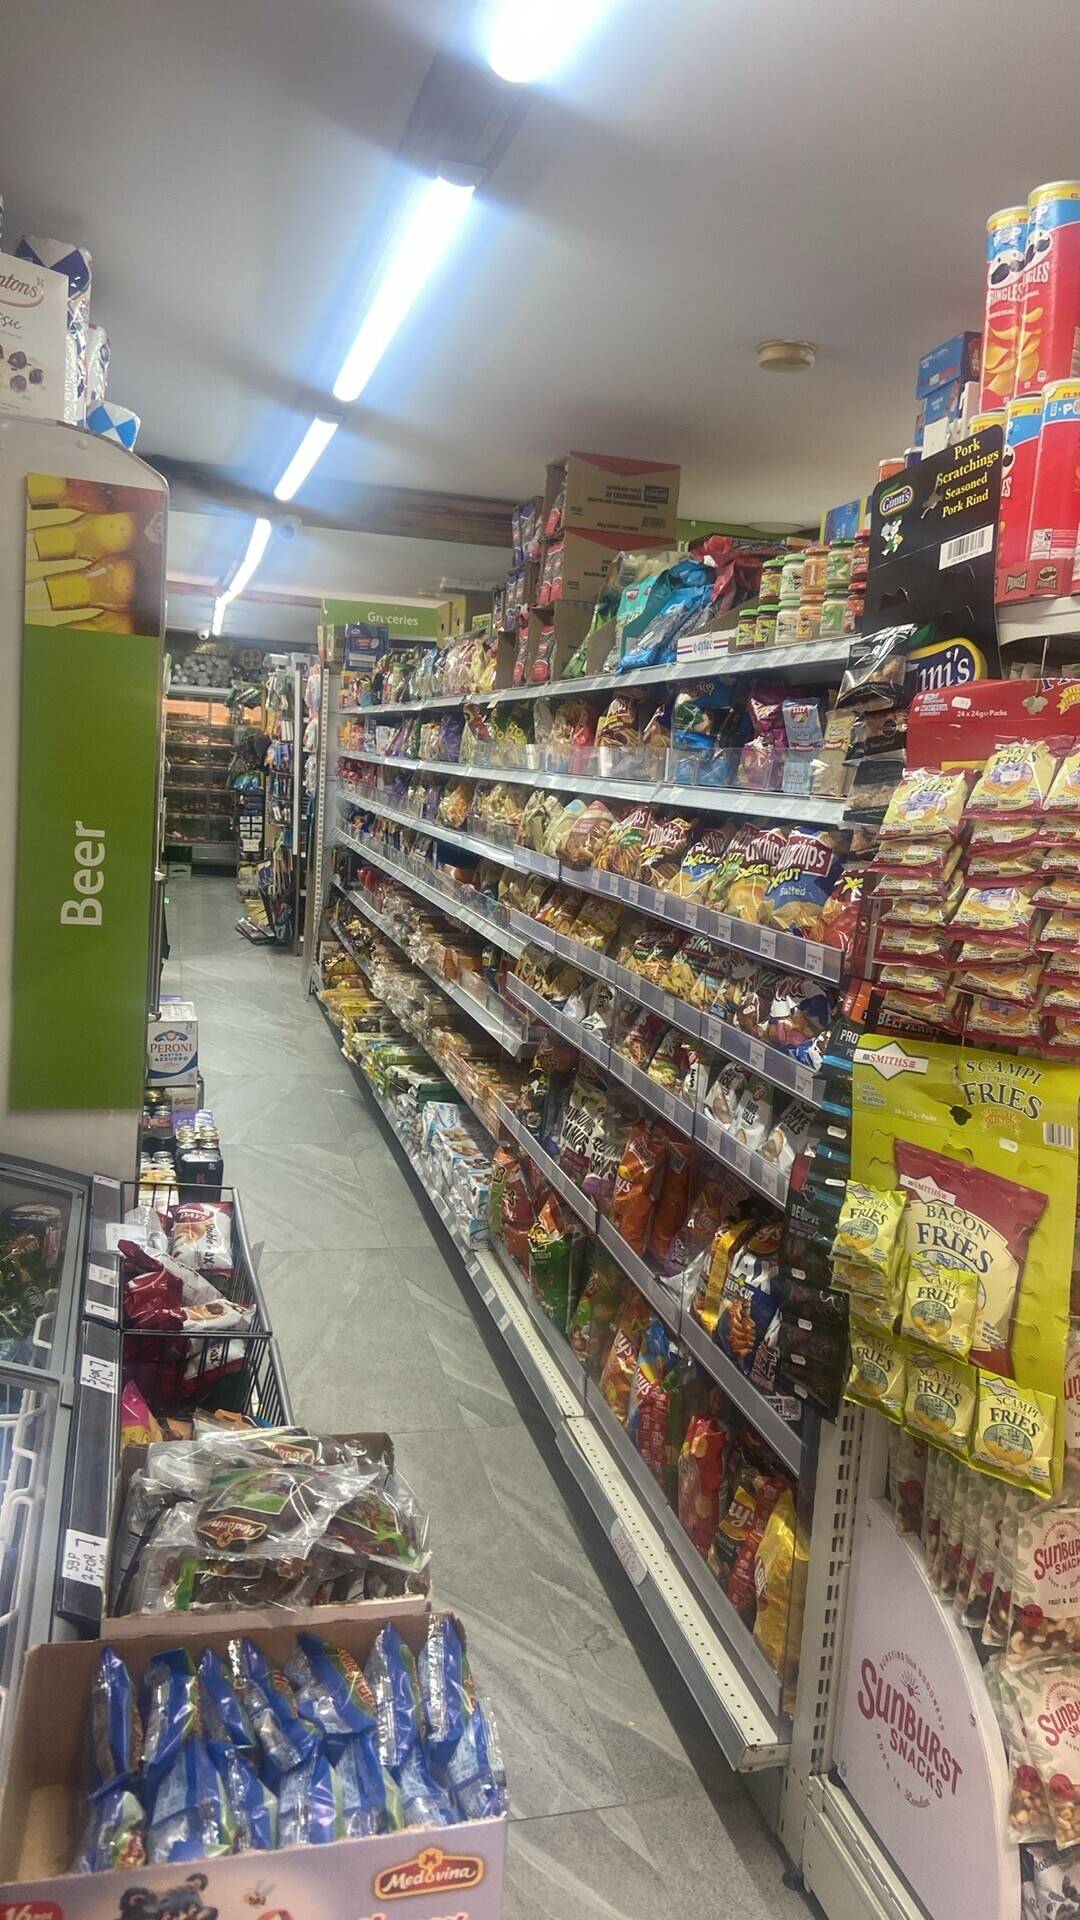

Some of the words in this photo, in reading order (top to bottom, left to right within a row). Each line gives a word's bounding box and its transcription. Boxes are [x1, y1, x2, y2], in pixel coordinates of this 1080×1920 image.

[953, 438, 981, 460] Pork
[937, 450, 999, 486] Scratchings
[945, 472, 988, 500] Seasoned
[942, 501, 964, 518] Pork
[965, 489, 989, 508] Rind
[367, 611, 418, 626] Groceries
[989, 708, 1008, 717] Packs
[60, 819, 106, 926] Beer
[150, 1043, 193, 1053] PERONI
[868, 1053, 910, 1068] SMITHS
[965, 1059, 1043, 1086] SCAMPI
[960, 1081, 1043, 1121] FRIES
[913, 1180, 944, 1199] SMITHS
[850, 1207, 888, 1226] FRIES
[926, 1204, 991, 1241] BACON
[916, 1222, 994, 1274] FRIES
[925, 1276, 962, 1294] SCAMPI
[917, 1286, 959, 1311] FRIES
[861, 1336, 895, 1356] SCAMPI
[856, 1346, 896, 1373] FRIES
[919, 1367, 962, 1389] SCAMPI
[917, 1378, 963, 1408] FRIES
[995, 1395, 1040, 1418] SCAMPI
[990, 1406, 1041, 1437] FRIES
[889, 1727, 943, 1800] SNACKS
[382, 1866, 476, 1892] Medovina
